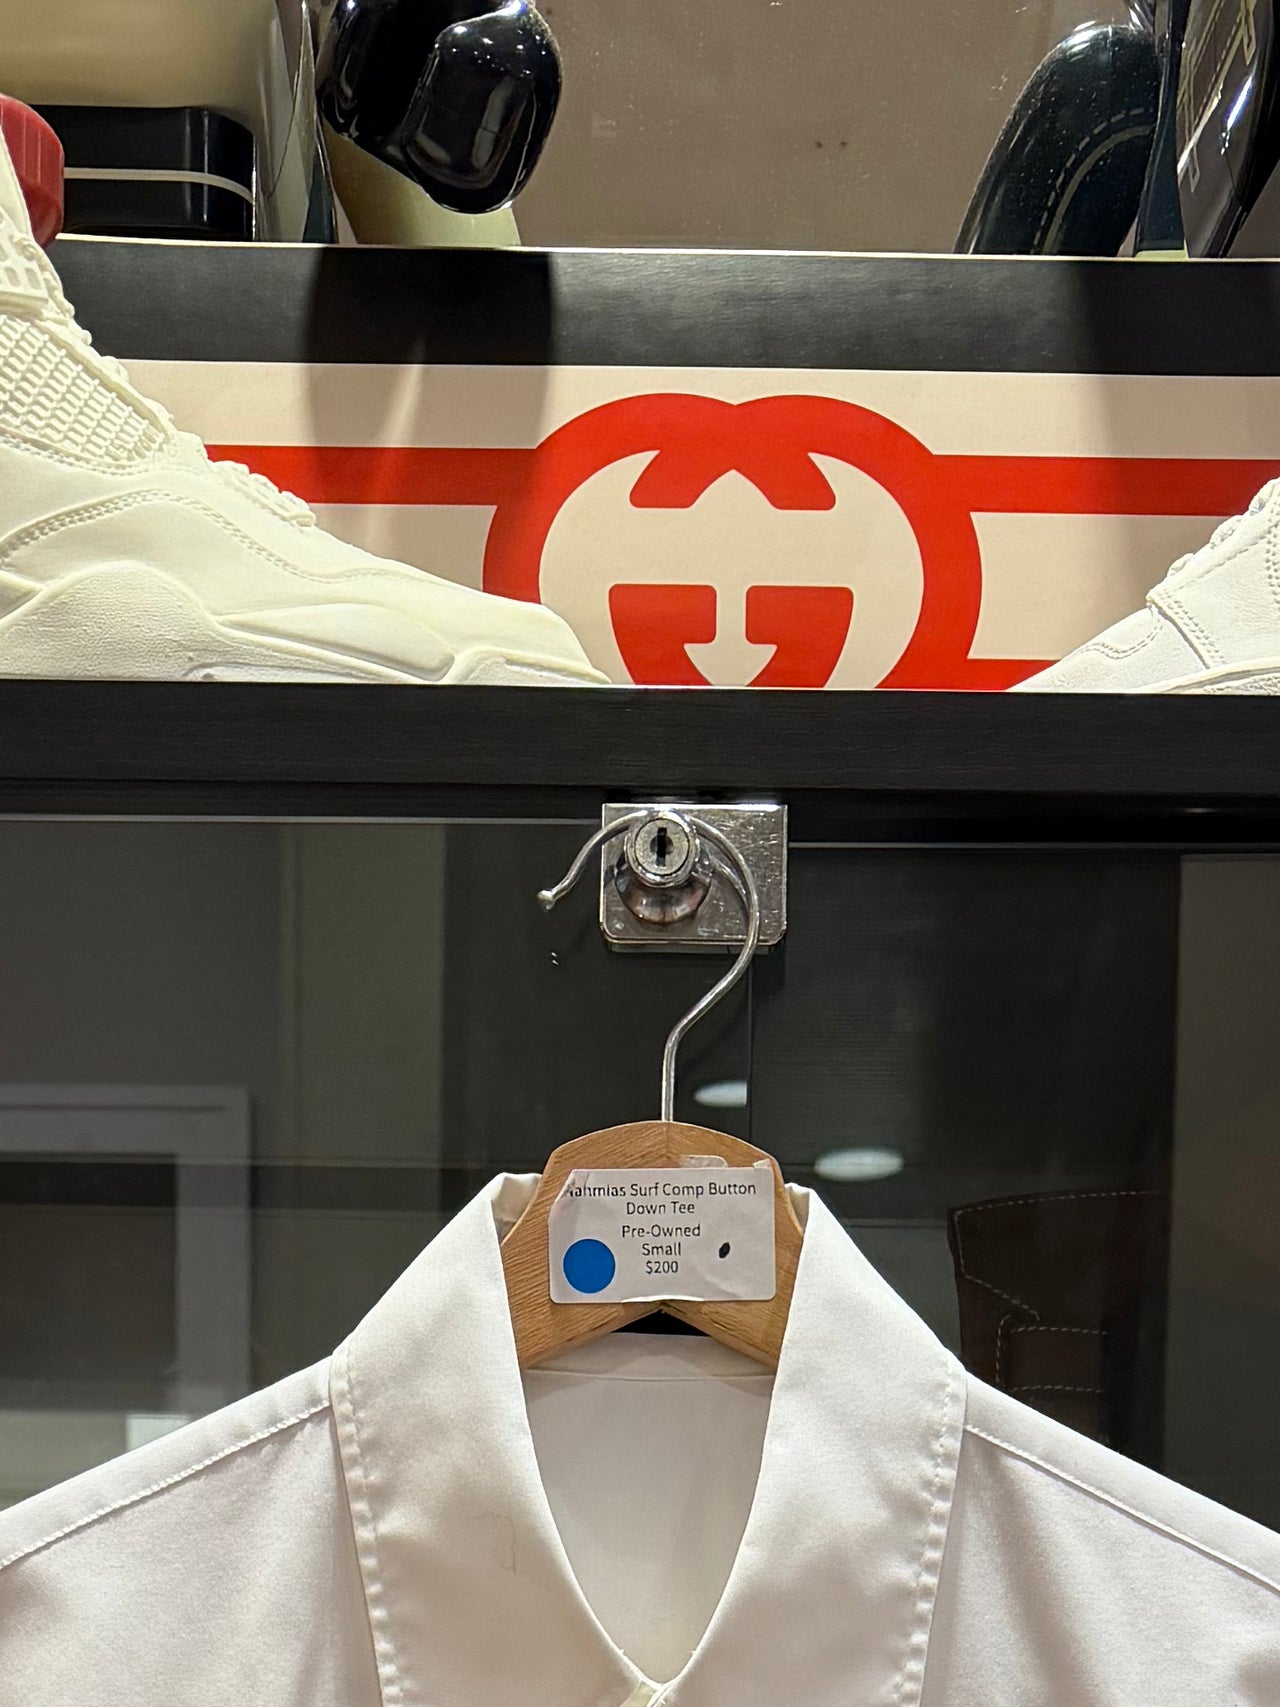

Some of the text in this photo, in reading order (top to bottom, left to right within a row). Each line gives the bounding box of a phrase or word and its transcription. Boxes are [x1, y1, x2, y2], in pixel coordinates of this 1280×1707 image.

[630, 1182, 660, 1198] Surf
[663, 1183, 704, 1199] Comp
[709, 1182, 757, 1197] Button
[626, 1201, 696, 1215] Down Tee
[622, 1223, 701, 1238] Pre-Owned
[642, 1242, 682, 1257] Small
[645, 1260, 679, 1275] $200
